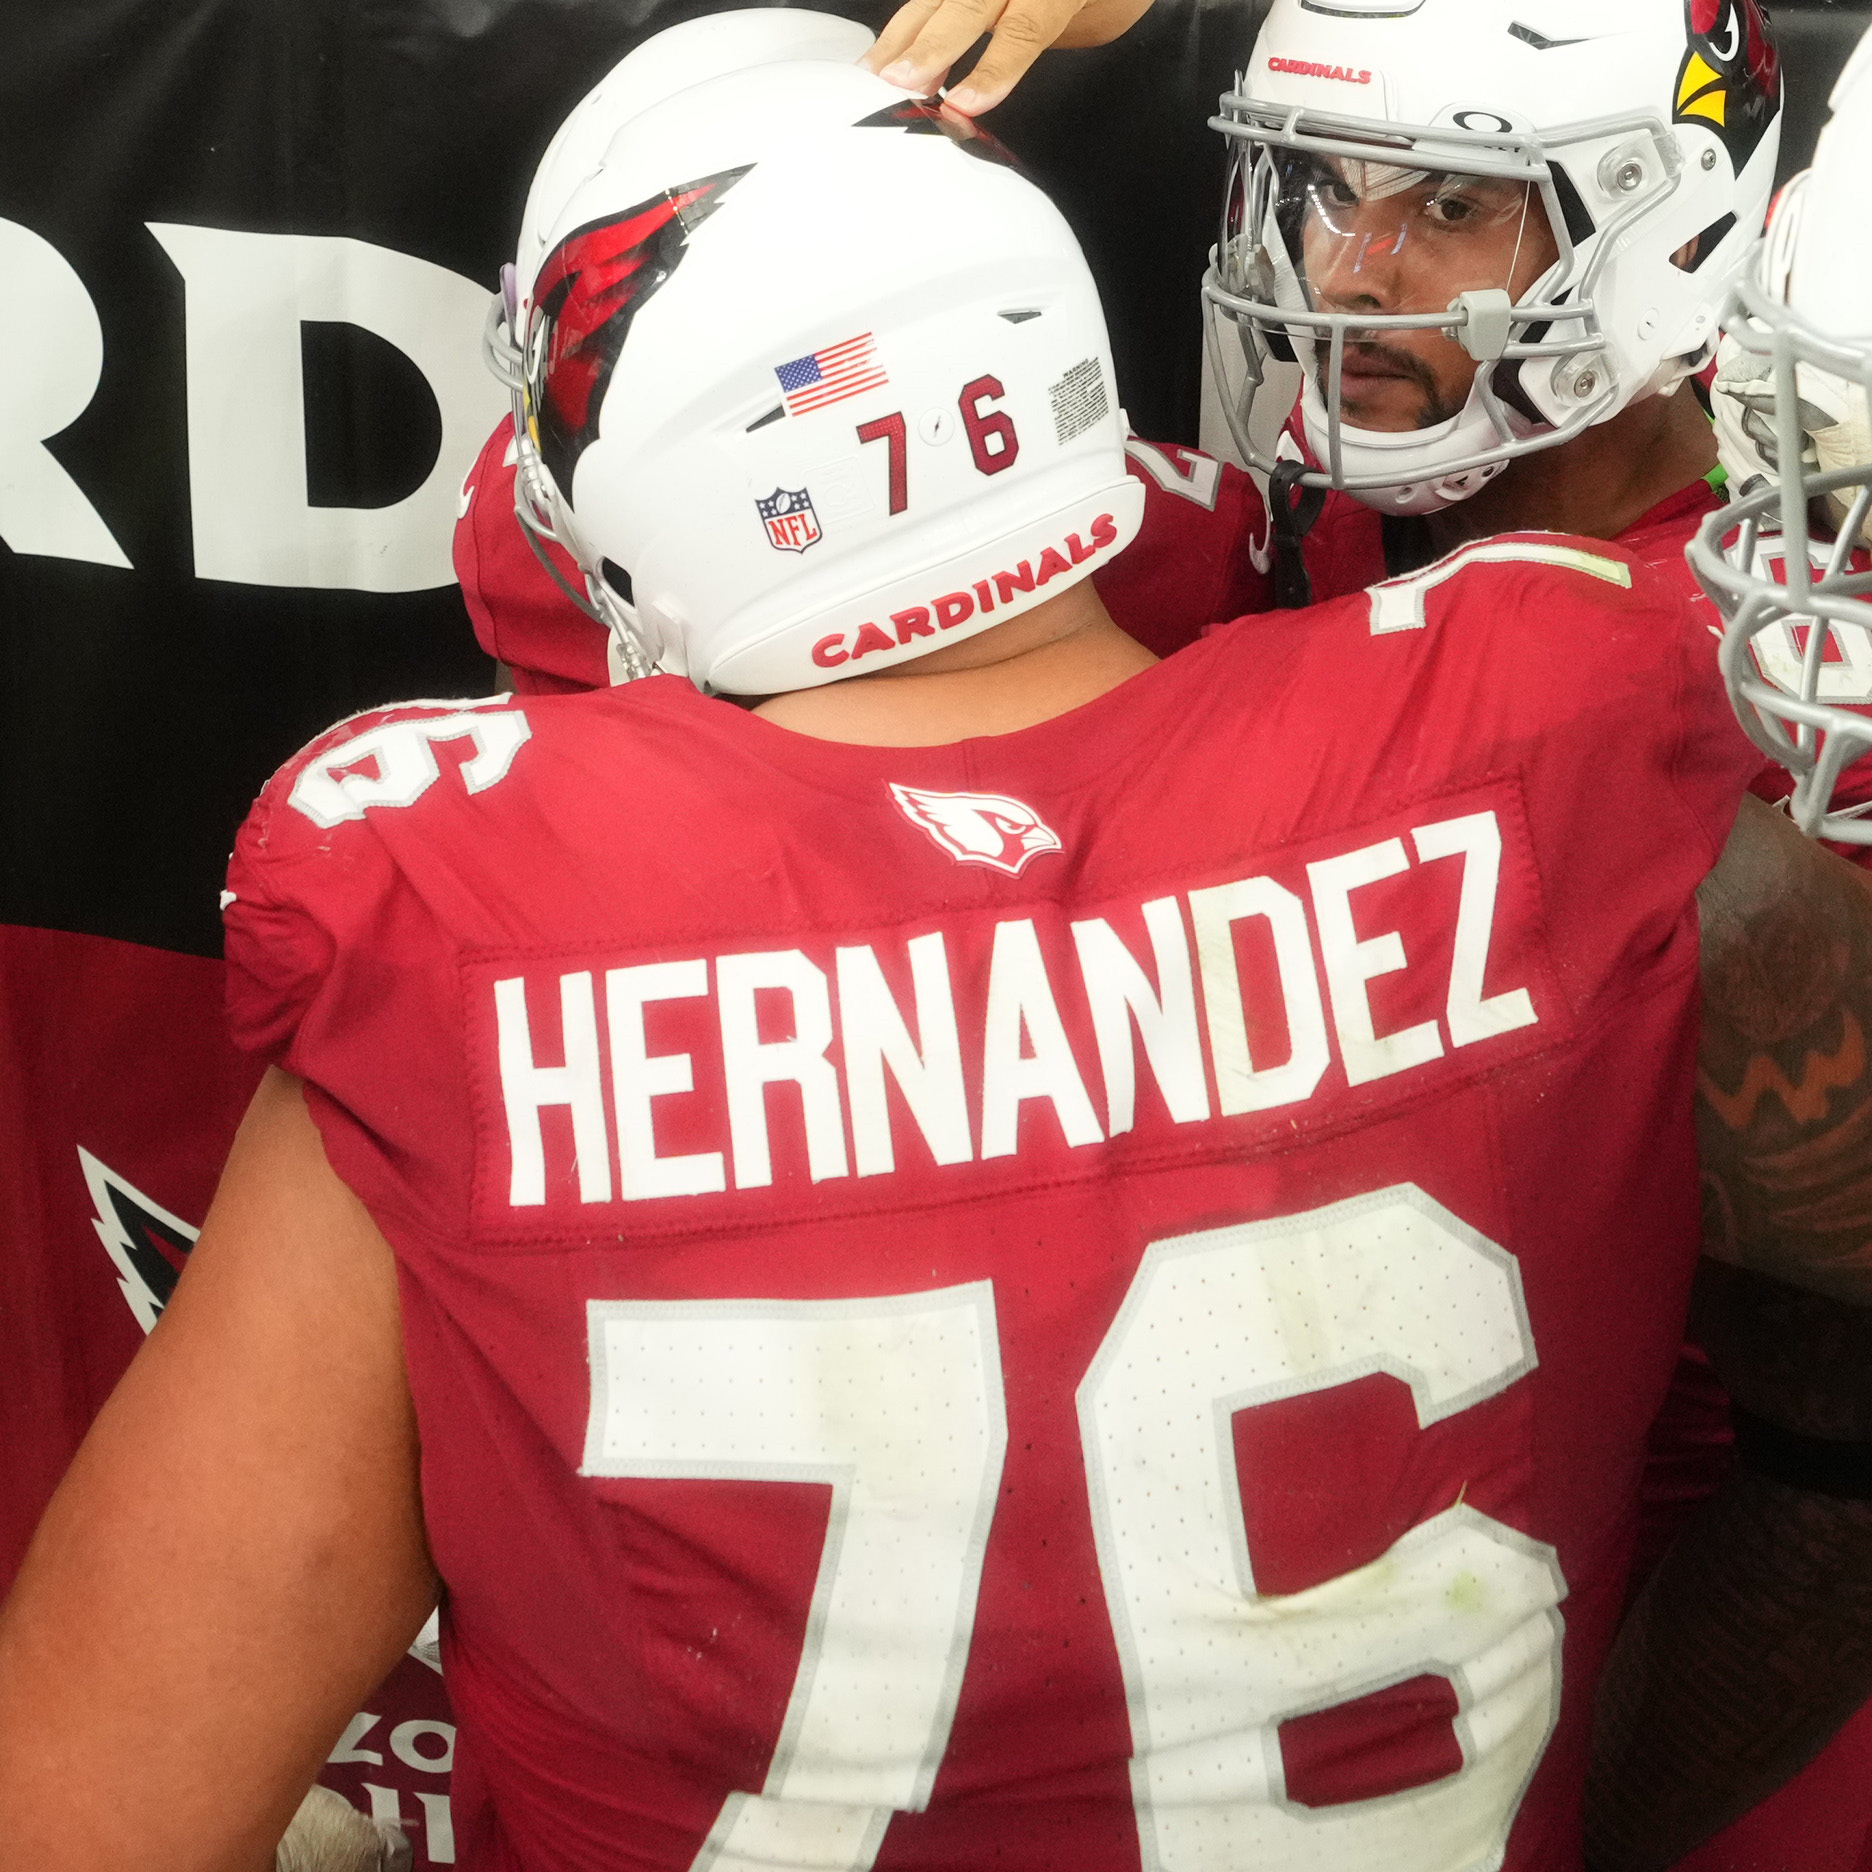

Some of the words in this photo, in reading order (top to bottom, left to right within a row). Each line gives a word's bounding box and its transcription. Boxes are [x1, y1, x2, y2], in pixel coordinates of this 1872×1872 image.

[767, 513, 818, 547] NFL
[811, 511, 1118, 669] CARDINALS
[492, 810, 1540, 1208] HERNANDEZ
[580, 1182, 1570, 1872] 76
